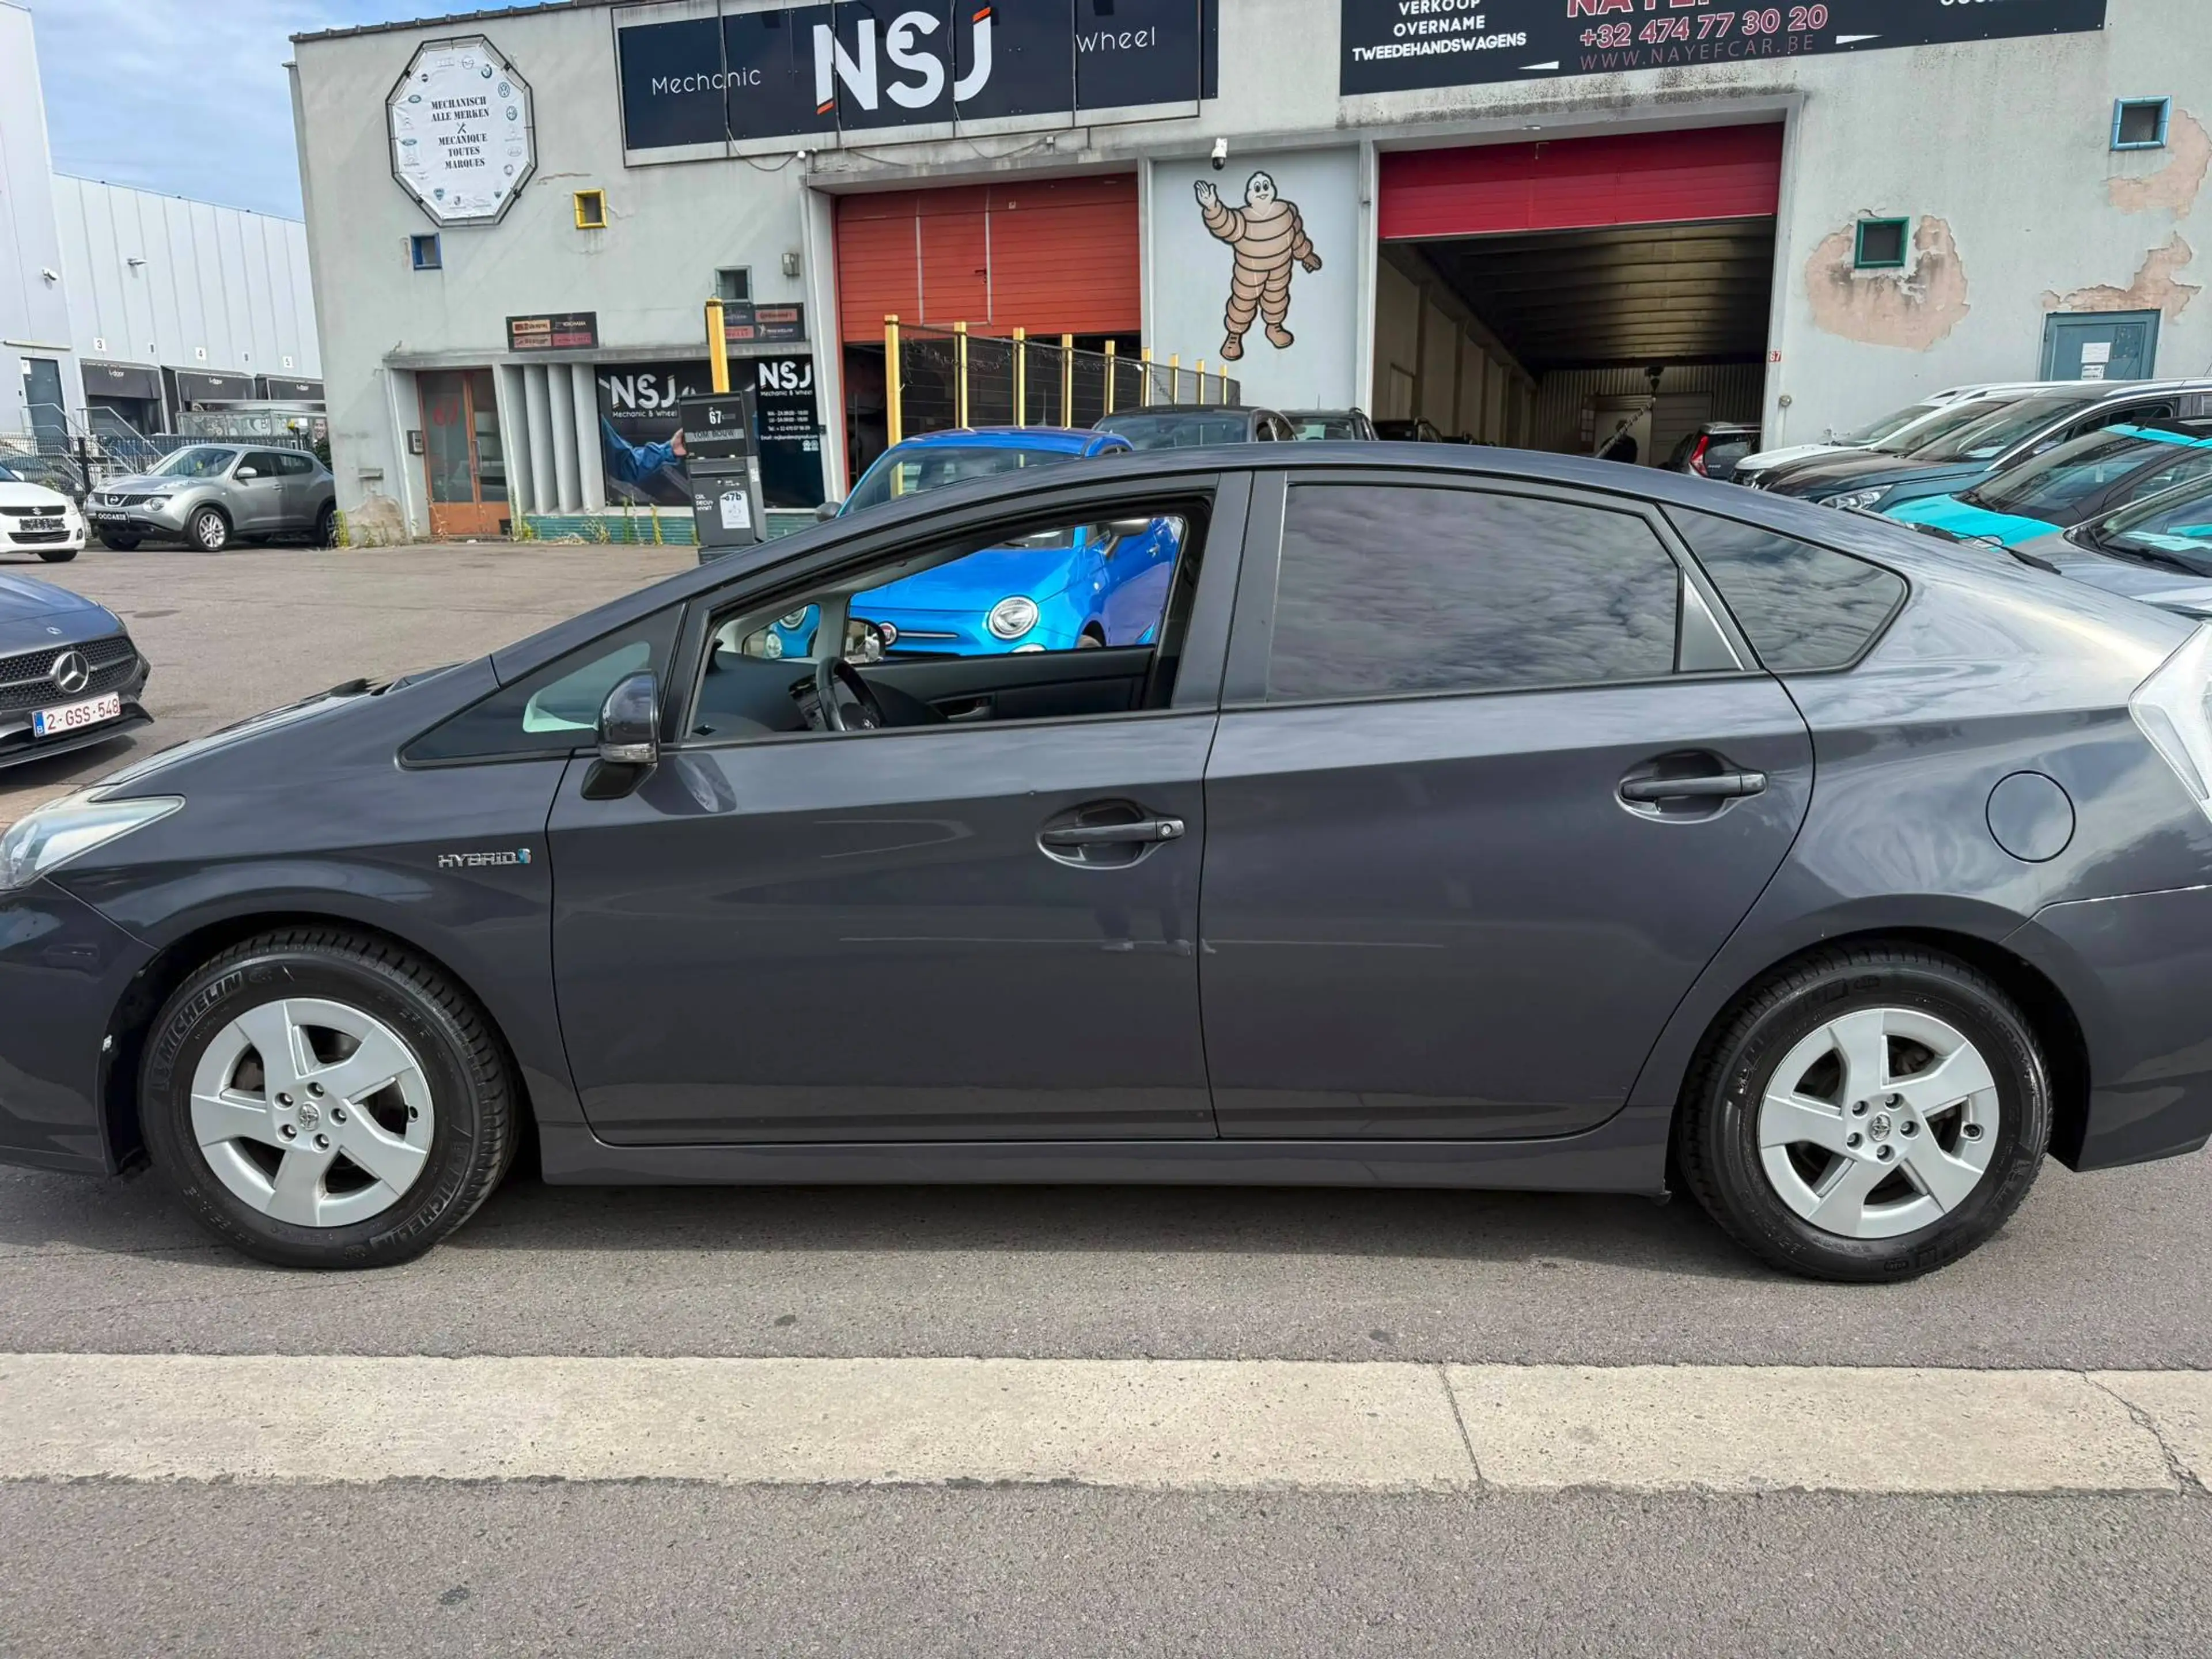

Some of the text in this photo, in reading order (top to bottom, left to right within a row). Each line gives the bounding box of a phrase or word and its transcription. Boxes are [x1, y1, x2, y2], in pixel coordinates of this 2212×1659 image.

[1399, 0, 1481, 16] VERKOOP
[1393, 16, 1485, 37] OVERNAME
[1580, 23, 1631, 49] +32
[1639, 17, 1690, 44] 474
[1697, 12, 1735, 39] 77
[1742, 8, 1781, 36] 30
[1787, 4, 1828, 31] 20
[1352, 32, 1527, 61] TWEEDEHANDSWAGENS
[1580, 34, 1814, 70] WWW.NAYEFCAR.BE
[813, 6, 992, 115] NSJ
[652, 67, 761, 96] Mechanic
[431, 96, 486, 109] MECHANISCH
[431, 108, 489, 122] ALLE MERKEN
[438, 133, 487, 146] MECANIQUE
[448, 146, 480, 157] TOUTES
[445, 158, 485, 169] MARQUES
[97, 340, 102, 349] 3
[758, 361, 812, 389] NSJ
[610, 373, 676, 410] NSJ
[709, 410, 722, 424] 67
[37, 725, 43, 733] B
[438, 852, 516, 868] HYBRID
[158, 970, 243, 1063] MICHELIN
